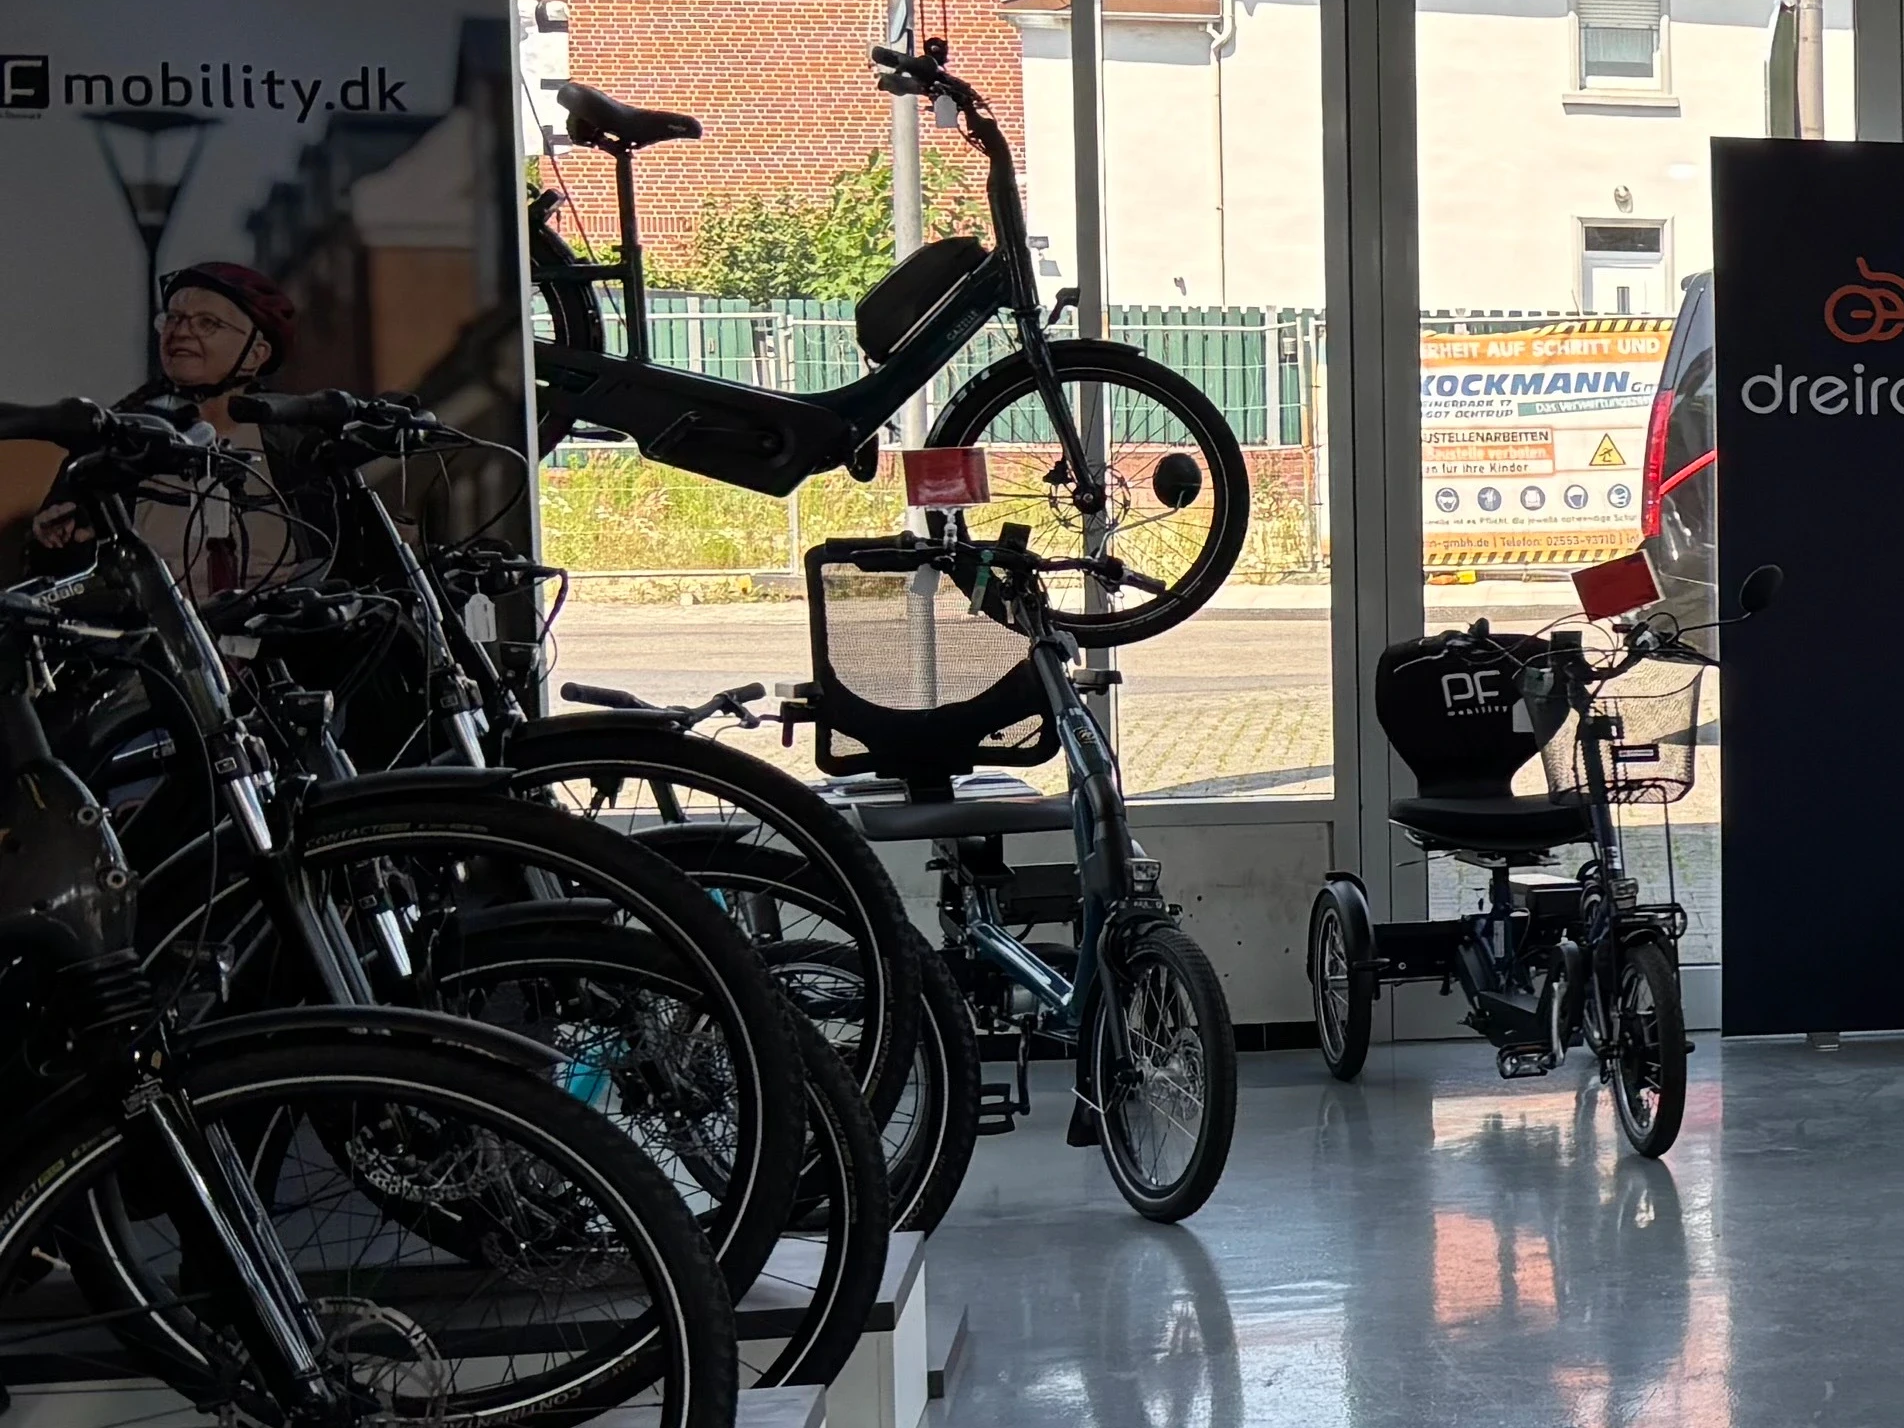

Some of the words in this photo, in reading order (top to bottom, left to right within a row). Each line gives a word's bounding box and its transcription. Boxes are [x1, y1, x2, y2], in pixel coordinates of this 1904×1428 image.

[64, 61, 408, 124] mobility.dk
[1487, 340, 1526, 357] AUF
[1532, 338, 1612, 358] SCHRITT
[1617, 336, 1660, 355] UND
[1441, 669, 1501, 708] PF
